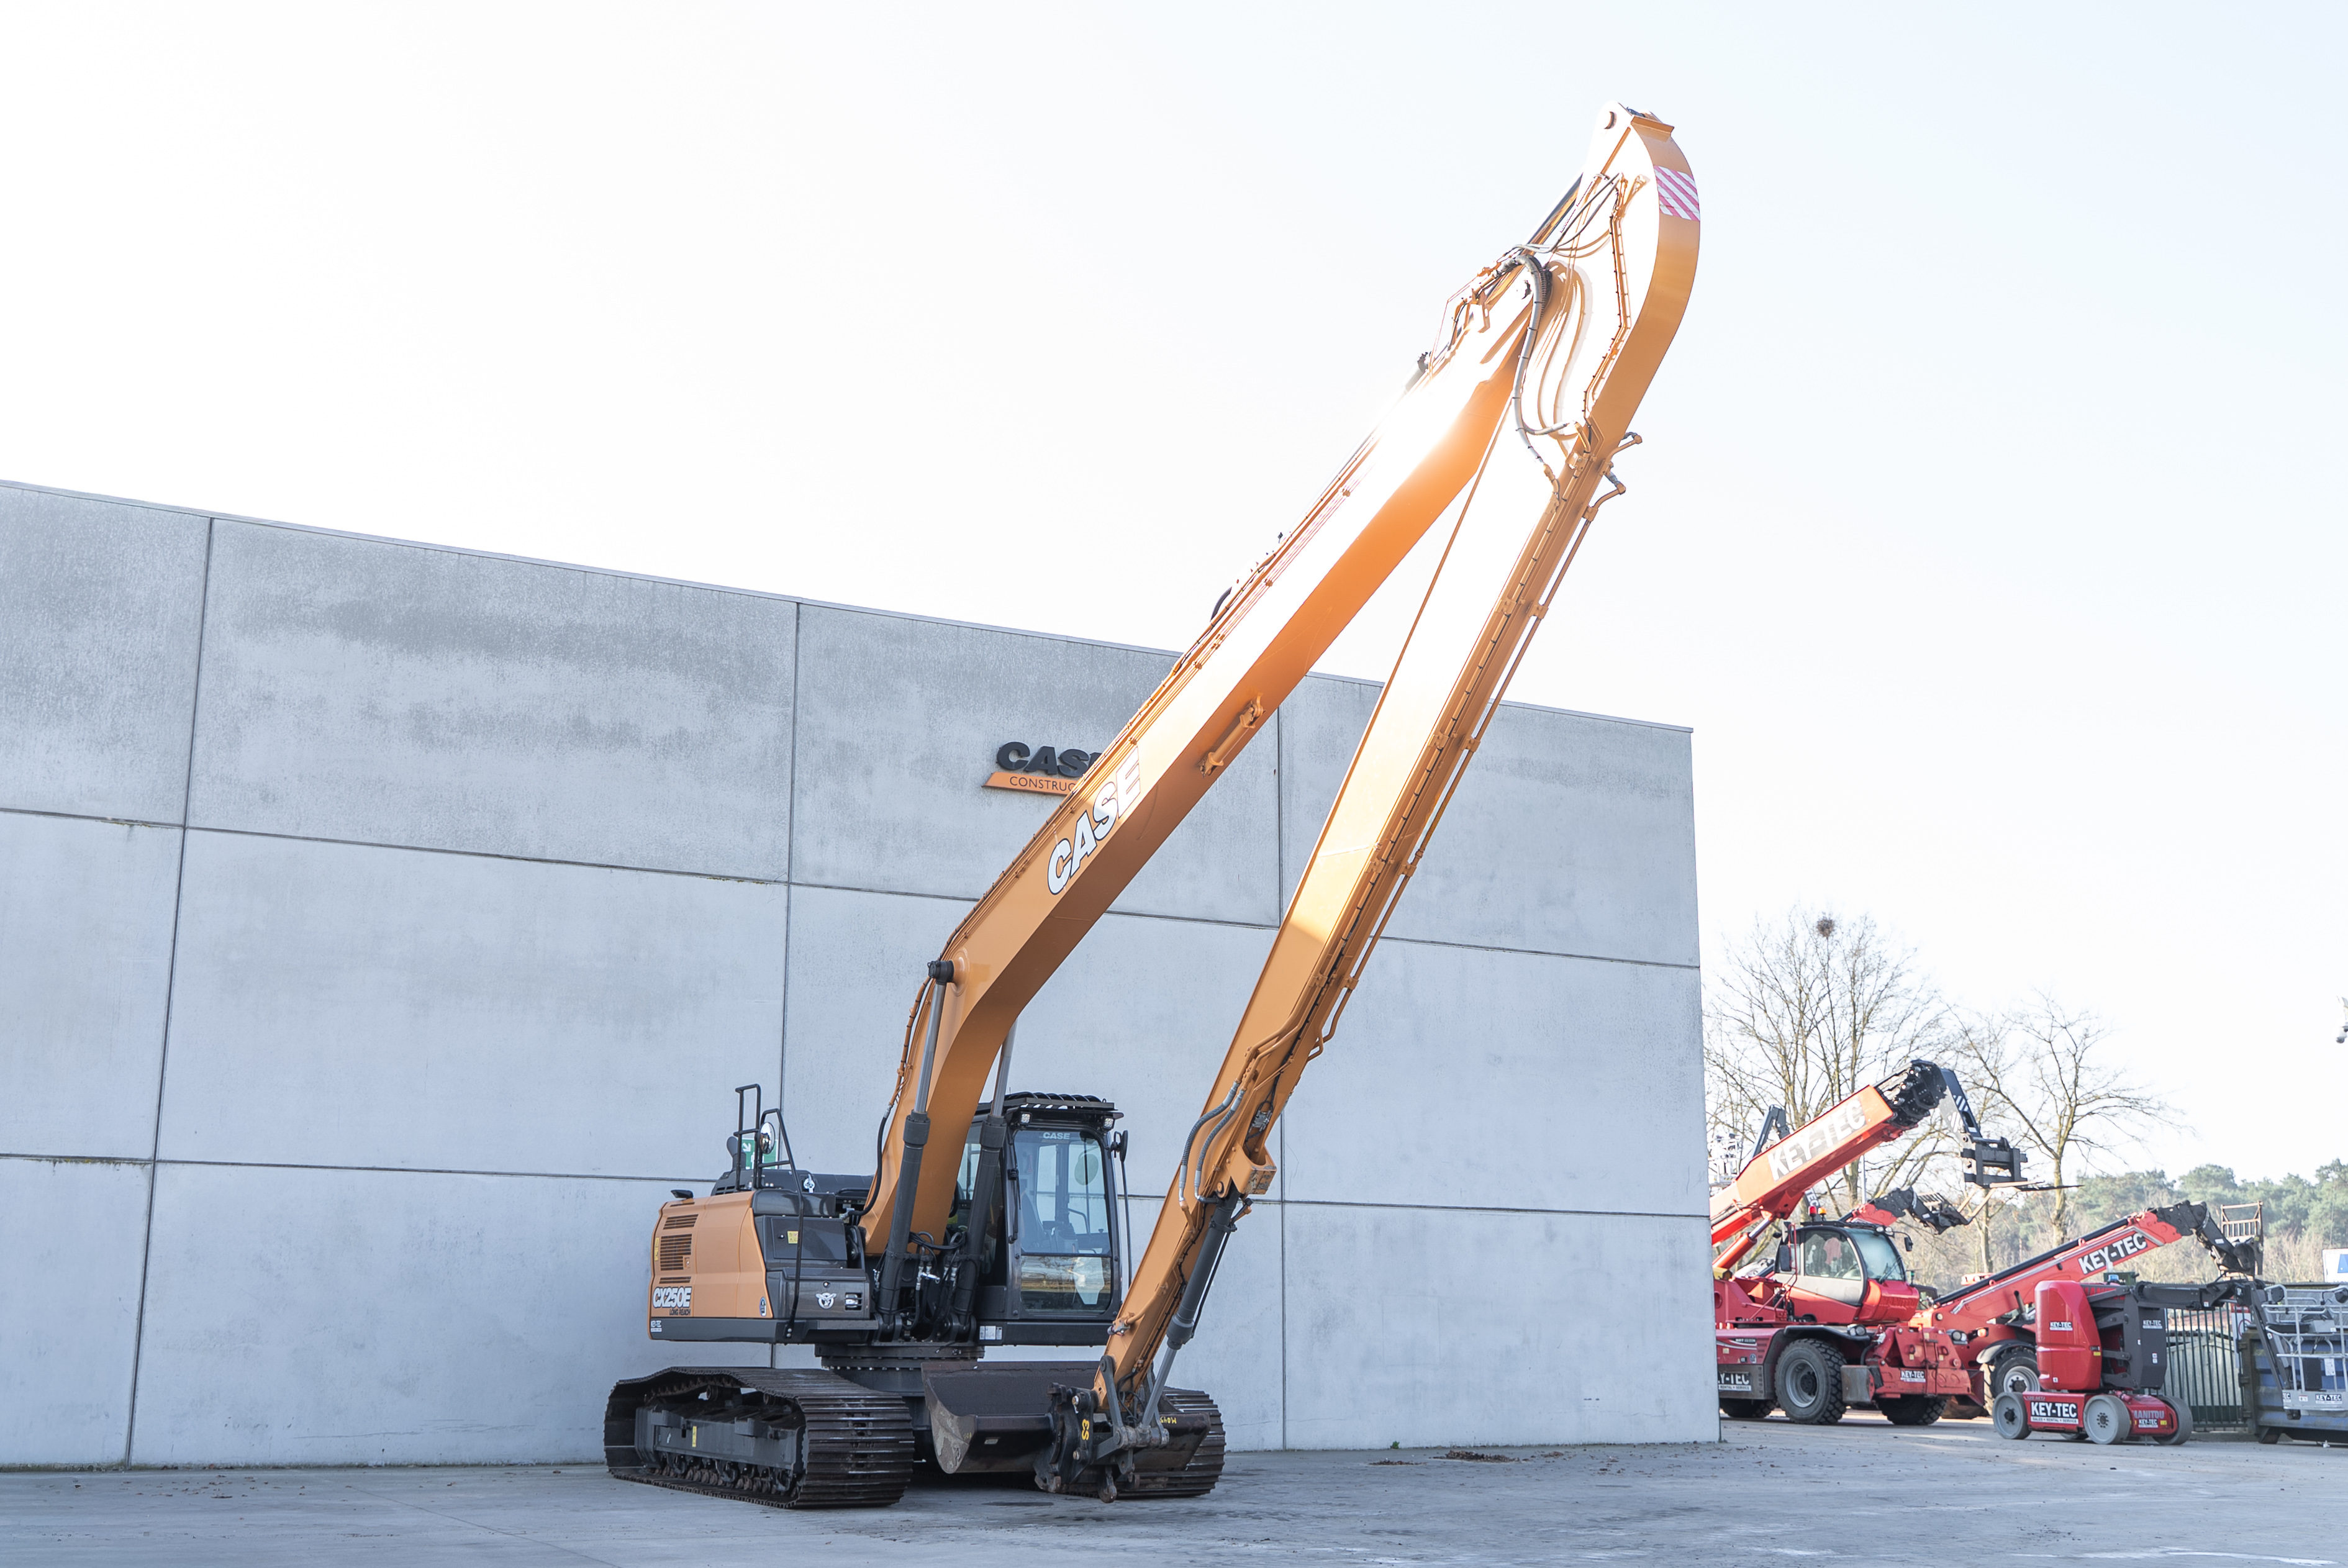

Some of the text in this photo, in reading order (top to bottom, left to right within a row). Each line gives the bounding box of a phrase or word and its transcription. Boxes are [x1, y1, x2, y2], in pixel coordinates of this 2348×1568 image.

[1010, 776, 1076, 792] CONSTRUC
[1047, 746, 1141, 895] CASE
[1767, 1100, 1865, 1181] KEY-TEC
[2078, 1233, 2147, 1275] KEY-TEC
[653, 1286, 692, 1308] CX250E
[1718, 1372, 1749, 1384] Y-TEC
[1901, 1370, 1924, 1378] KEY-TEC
[2031, 1402, 2077, 1418] KEY-TEC
